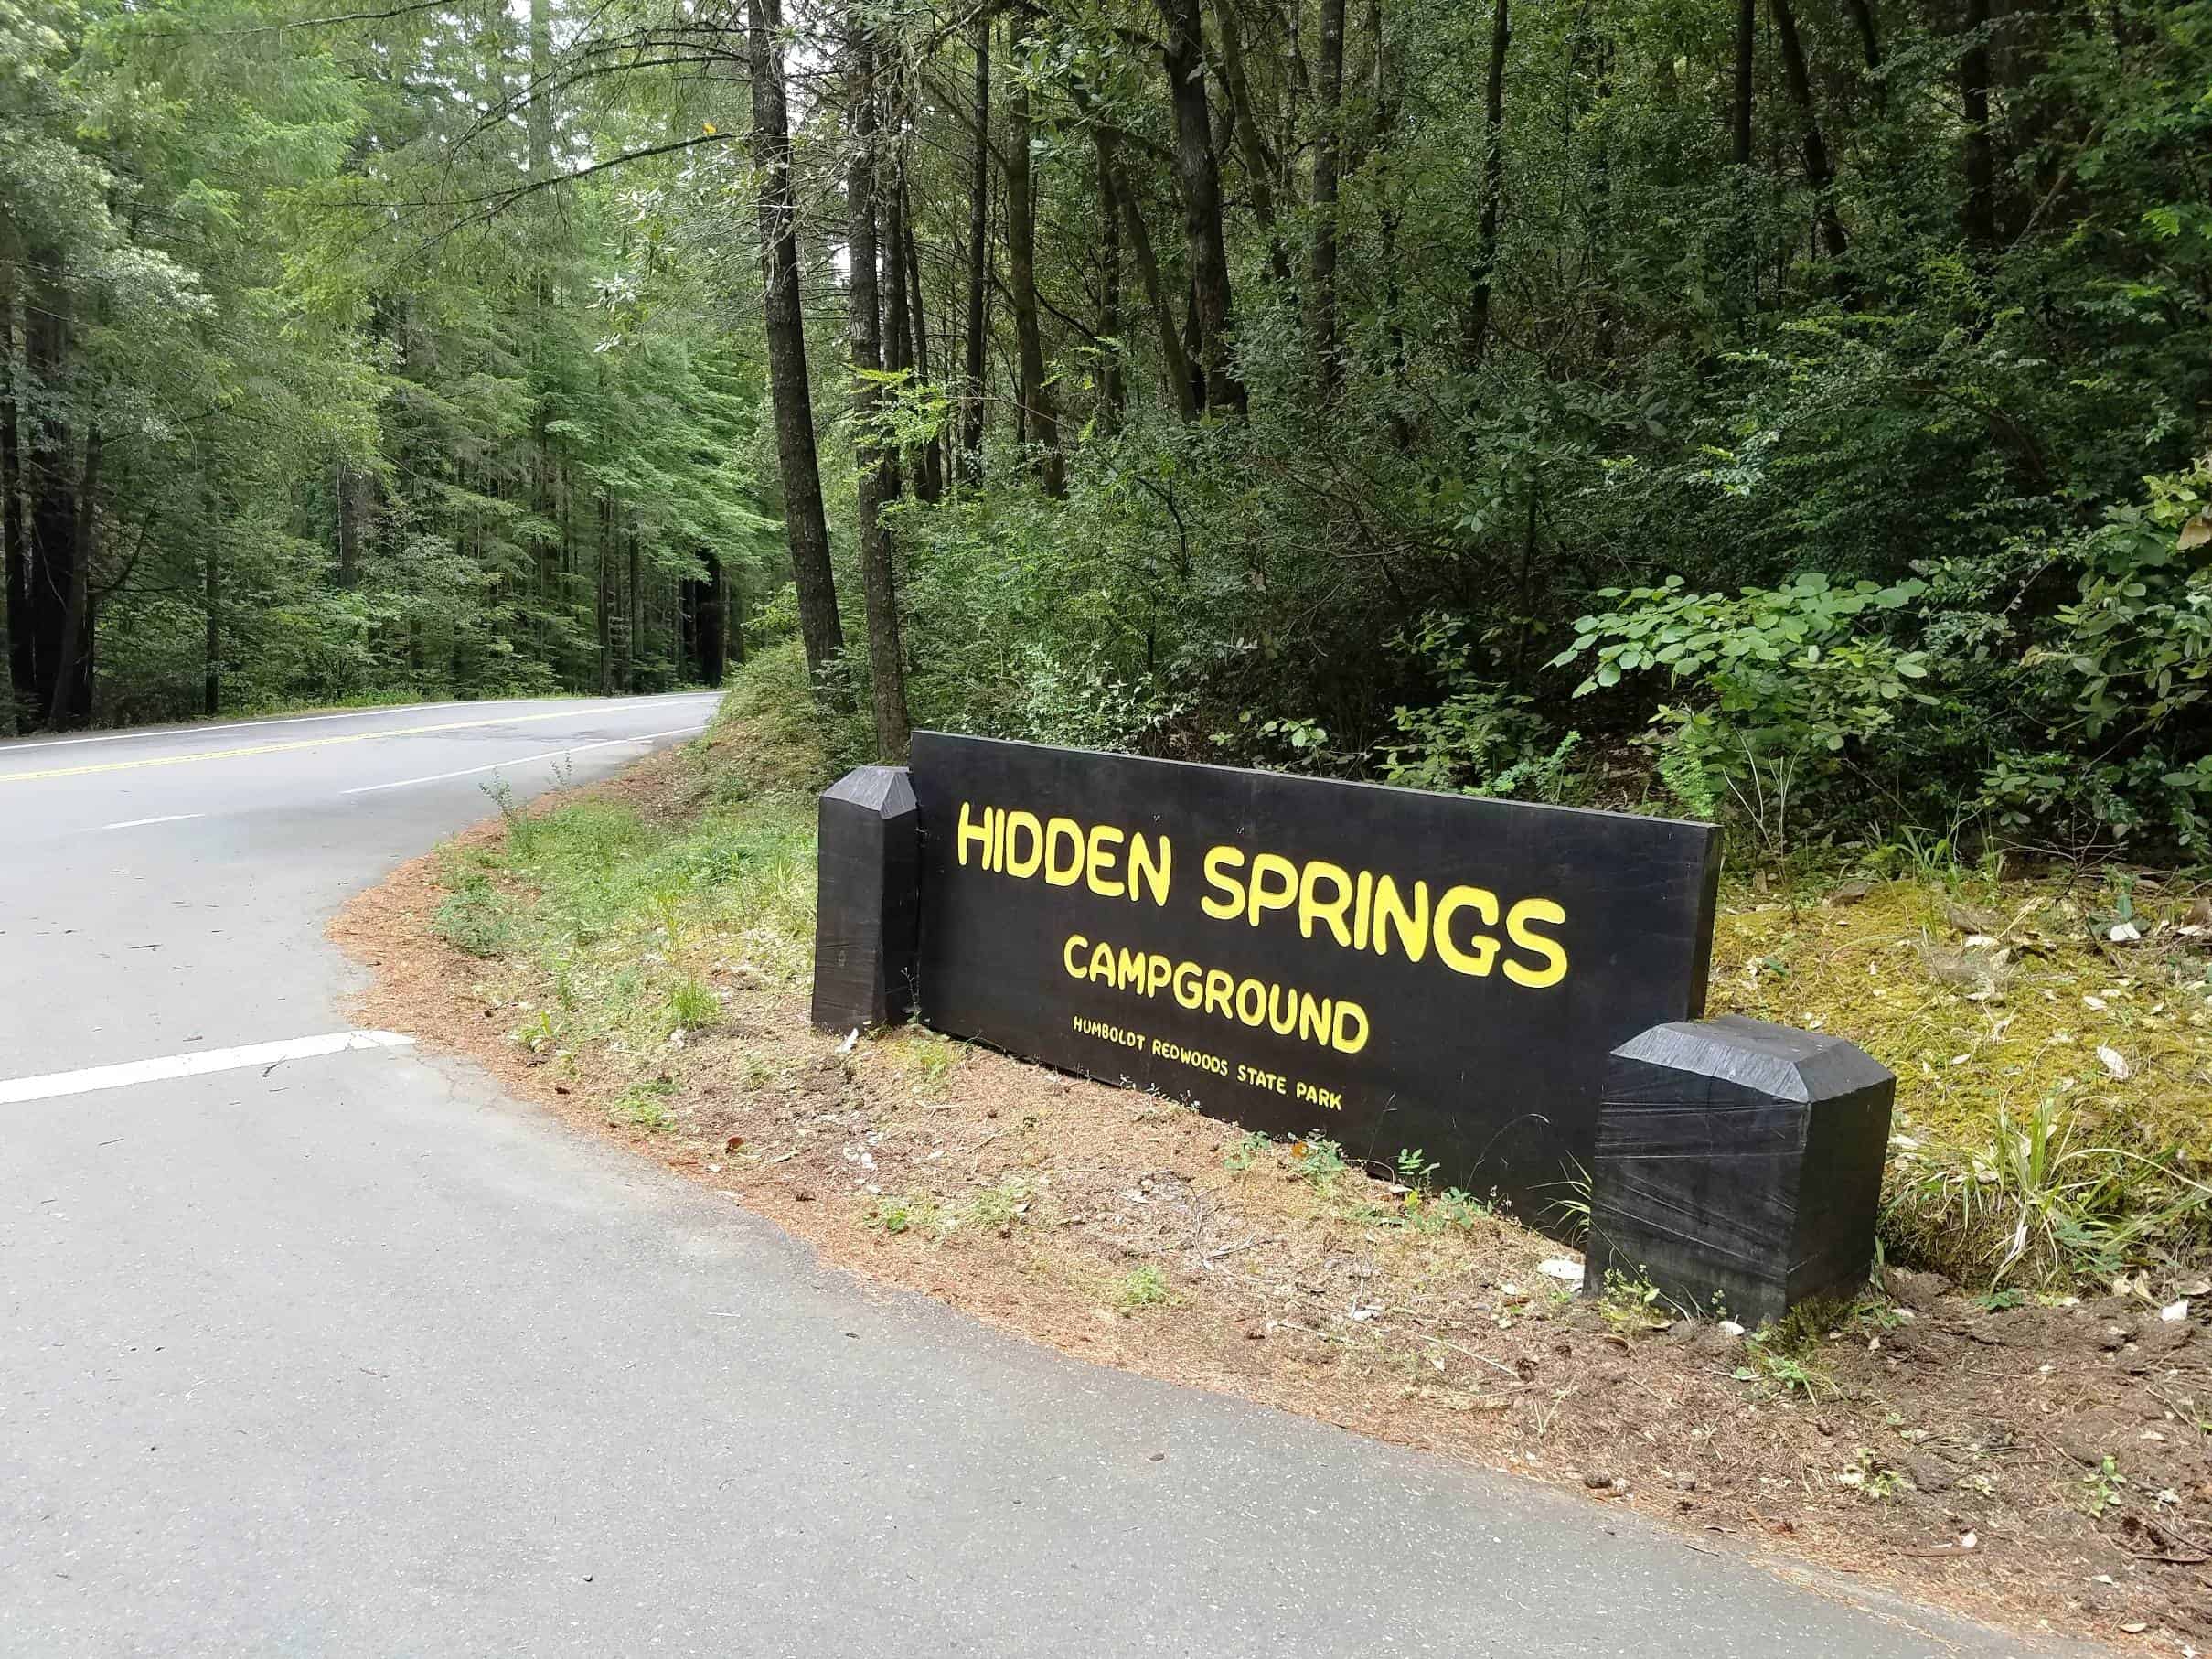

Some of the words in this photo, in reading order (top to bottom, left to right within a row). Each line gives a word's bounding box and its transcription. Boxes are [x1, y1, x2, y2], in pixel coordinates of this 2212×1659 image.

[957, 801, 1172, 906] HIDDEN
[1201, 845, 1568, 989] SPRINGS
[1063, 933, 1370, 1054] CAMPGROUND
[1073, 1016, 1145, 1051] HUMBOLDT
[1152, 1038, 1228, 1076] REDWOODS
[1237, 1065, 1287, 1095] STATE
[1296, 1081, 1342, 1110] PARK
